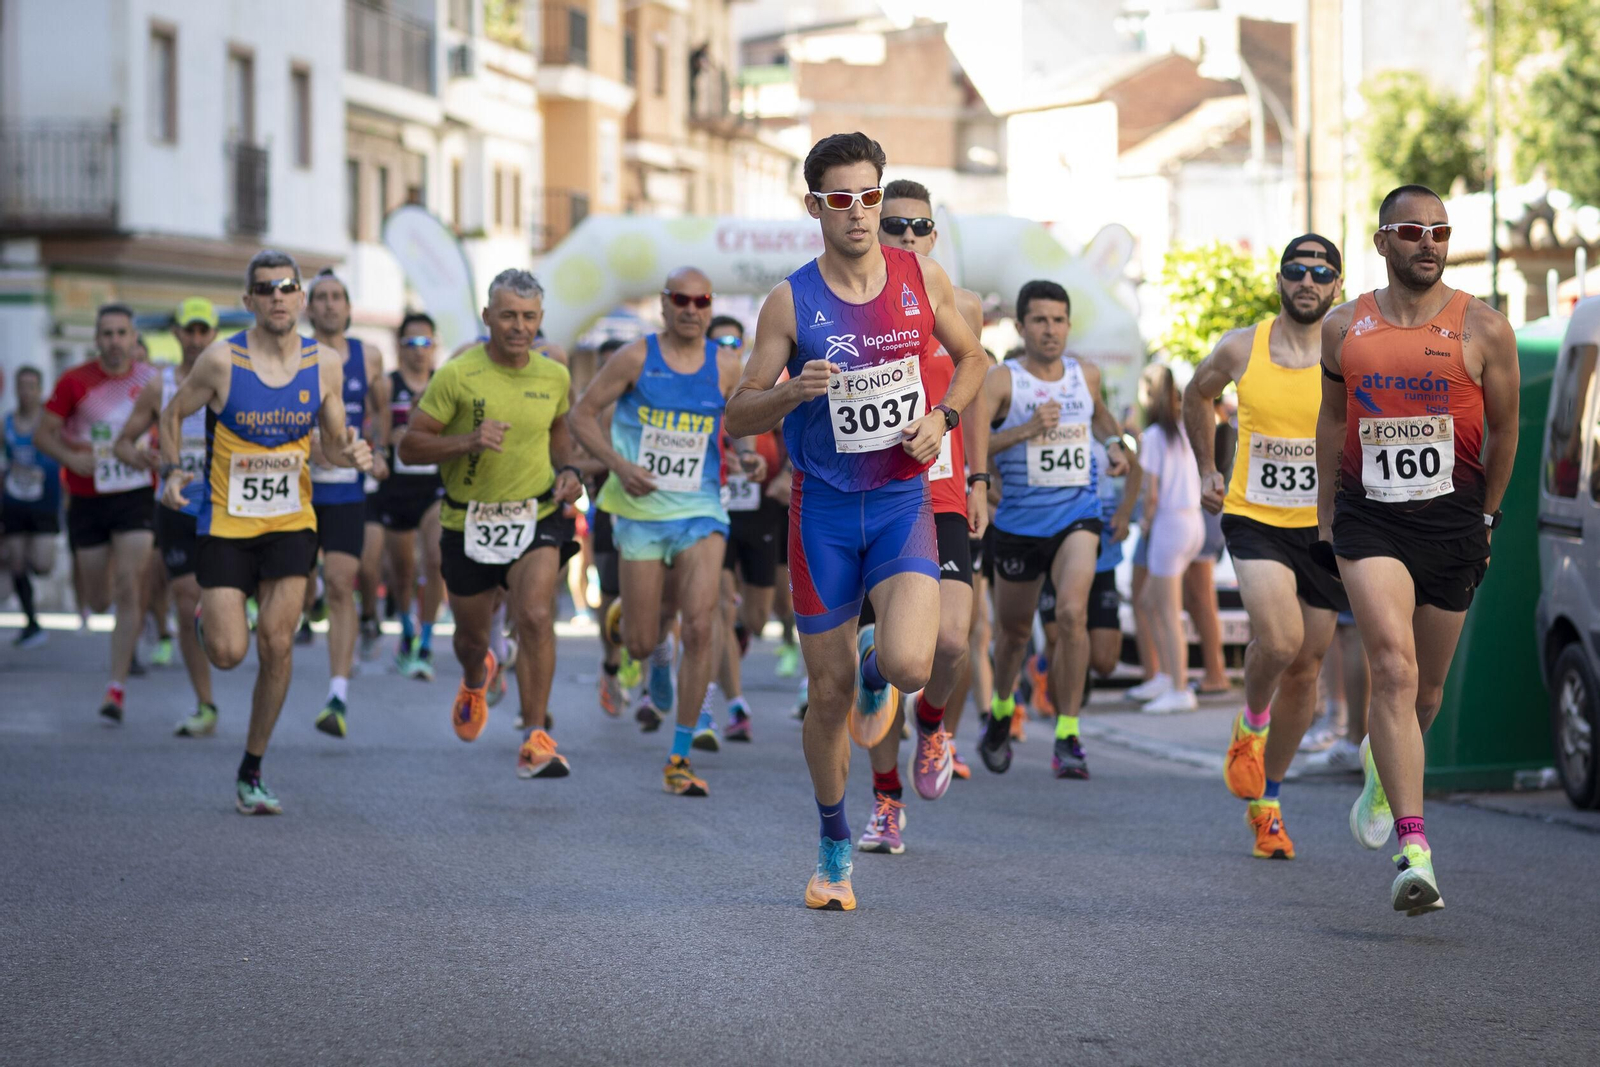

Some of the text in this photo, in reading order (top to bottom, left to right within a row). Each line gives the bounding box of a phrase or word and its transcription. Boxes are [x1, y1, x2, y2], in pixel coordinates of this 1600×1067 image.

[717, 229, 824, 252] Cruzca
[863, 329, 919, 350] lapalma
[1430, 324, 1461, 341] TRACK
[848, 370, 903, 392] FONDO
[1362, 371, 1448, 392] atracón
[1404, 392, 1448, 404] running
[235, 408, 312, 428] agustinos
[837, 391, 919, 434] 3037
[655, 434, 696, 448] FONDO
[1376, 424, 1434, 438] FONDO
[1040, 448, 1085, 472] 546
[1267, 443, 1314, 456] FONDO
[247, 458, 290, 470] FONDO
[643, 452, 699, 477] 3047
[1376, 447, 1440, 480] 160
[242, 474, 289, 501] 554
[1261, 463, 1316, 491] 833
[476, 524, 525, 547] 327
